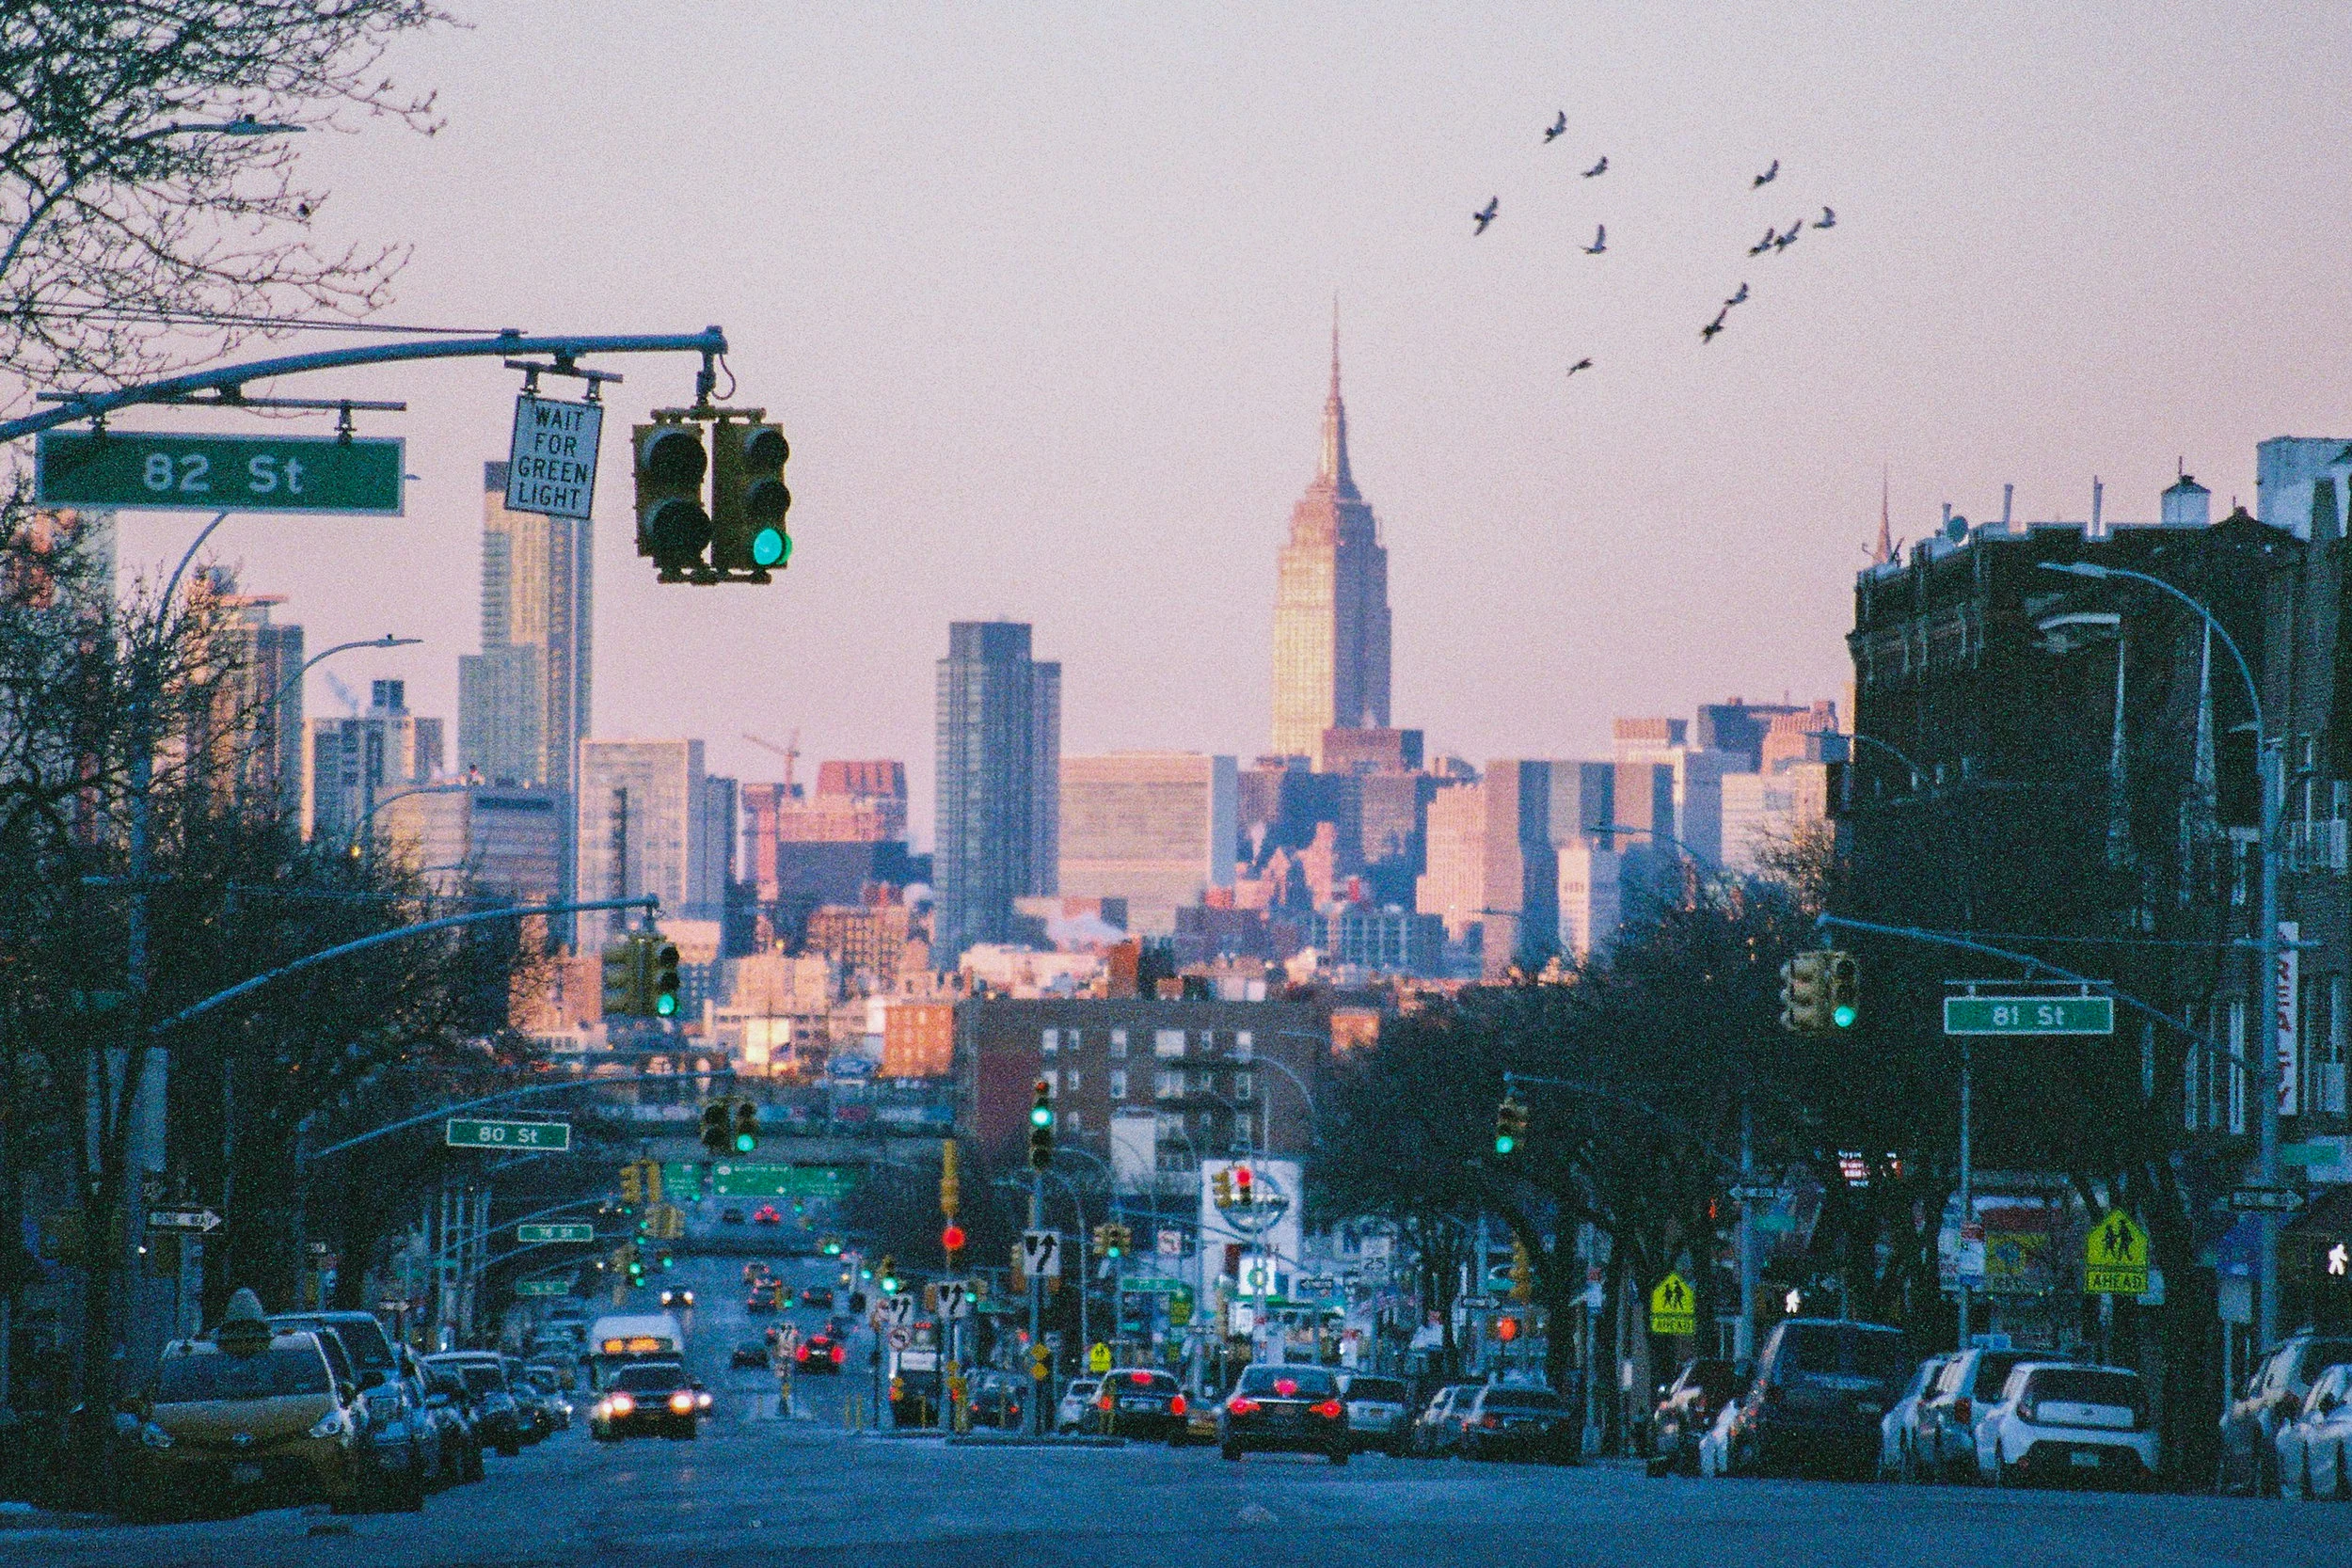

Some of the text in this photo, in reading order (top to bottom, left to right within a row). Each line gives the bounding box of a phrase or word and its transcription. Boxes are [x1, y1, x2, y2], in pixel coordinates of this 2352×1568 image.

[534, 405, 584, 432] WAIT
[533, 433, 578, 457] FOR
[145, 452, 304, 494] 82 St
[517, 455, 588, 485] GREEN
[518, 482, 580, 509] LIGHT
[1993, 1005, 2065, 1026] 81 St
[479, 1126, 537, 1144] 80 St
[2093, 1274, 2142, 1289] AHEAD
